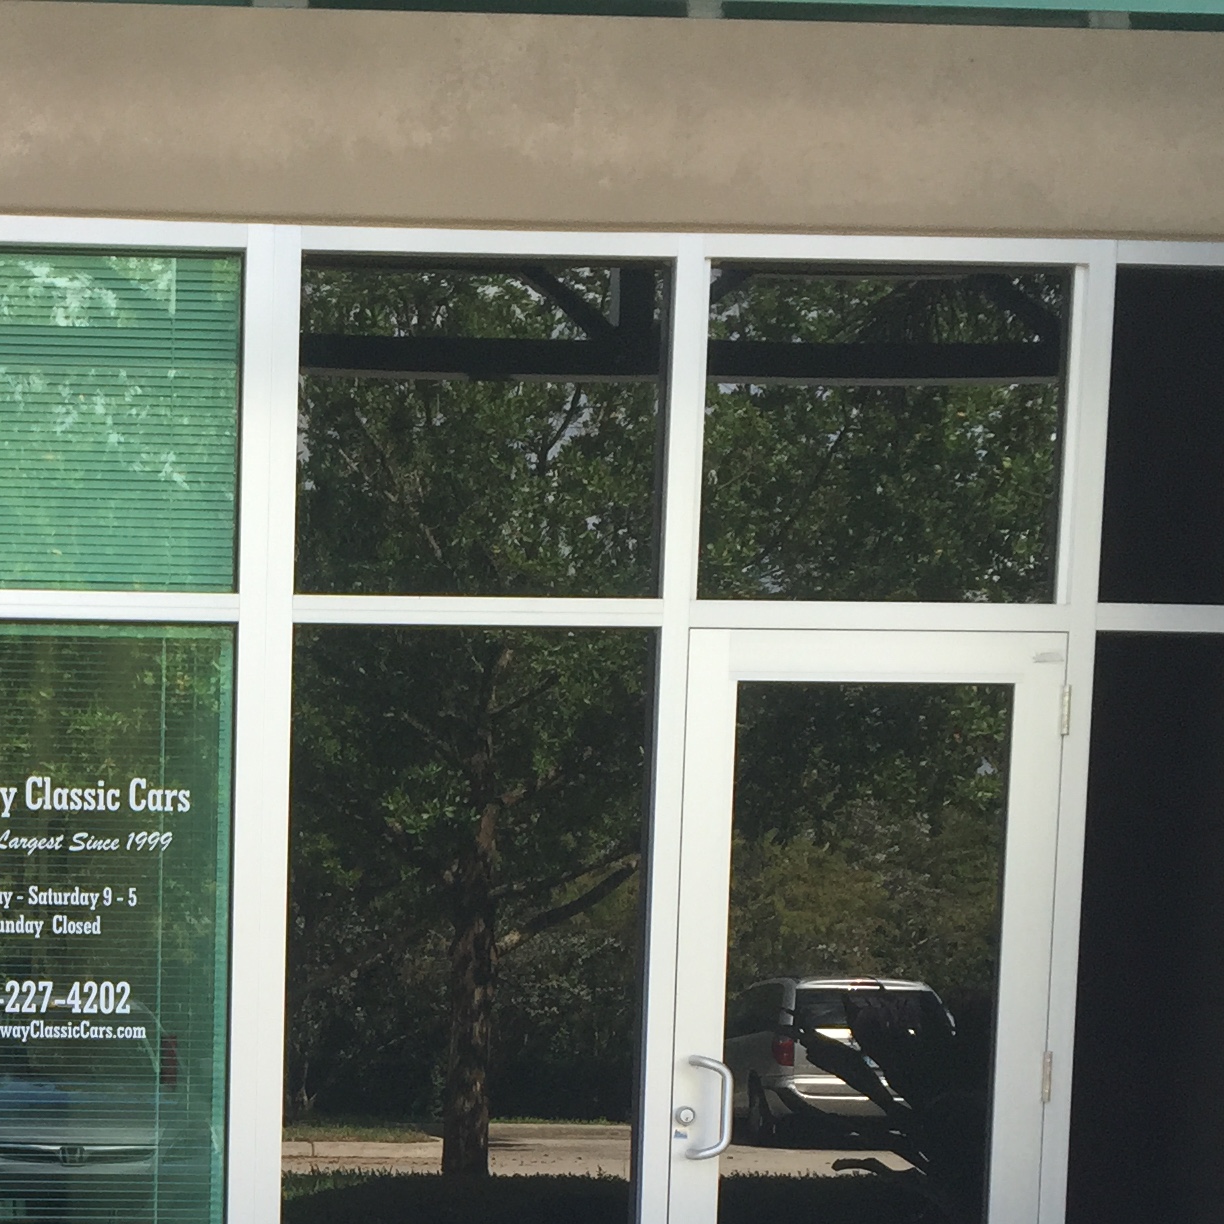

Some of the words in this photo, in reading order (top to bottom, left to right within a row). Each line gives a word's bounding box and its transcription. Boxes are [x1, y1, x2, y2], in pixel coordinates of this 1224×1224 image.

[26, 776, 120, 812] Classic
[129, 777, 191, 813] Cars
[69, 832, 120, 851] Since
[125, 831, 173, 850] 1999
[28, 887, 100, 910] Saturday
[103, 887, 111, 906] 9
[128, 888, 137, 907] 5
[52, 915, 102, 935] Closed
